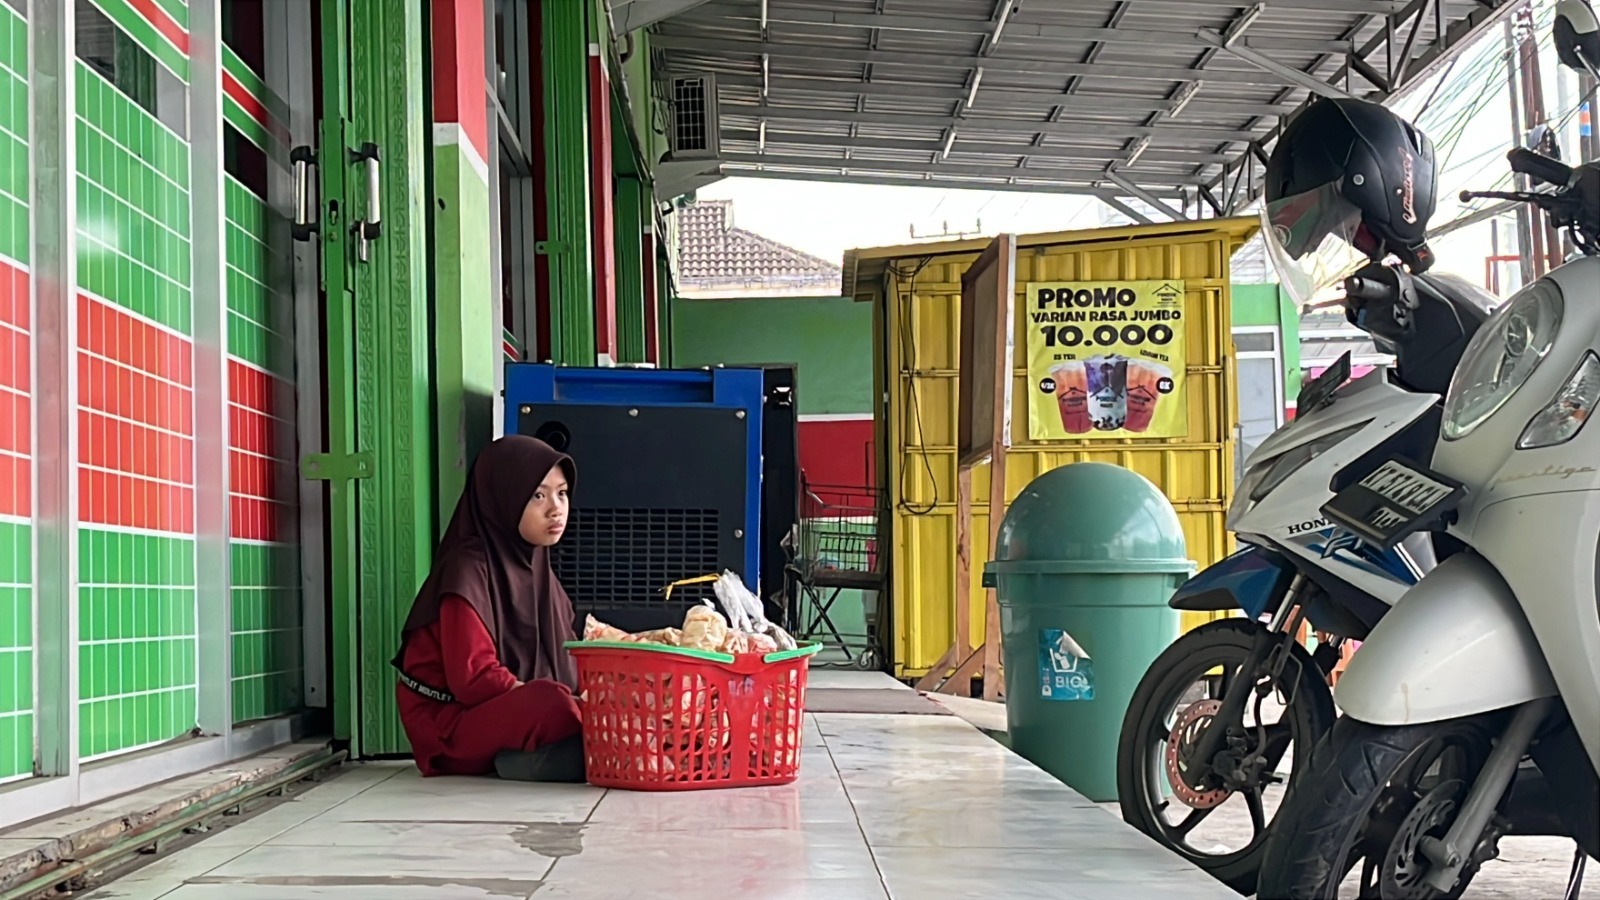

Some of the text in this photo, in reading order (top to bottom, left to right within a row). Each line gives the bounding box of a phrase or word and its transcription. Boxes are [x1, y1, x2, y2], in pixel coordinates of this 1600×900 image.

[1038, 287, 1136, 309] PROMO
[1031, 310, 1181, 323] VARIAN RASA JUMBO
[1041, 324, 1173, 347] 10.000
[1159, 353, 1169, 362] TEA
[1288, 517, 1332, 535] HON
